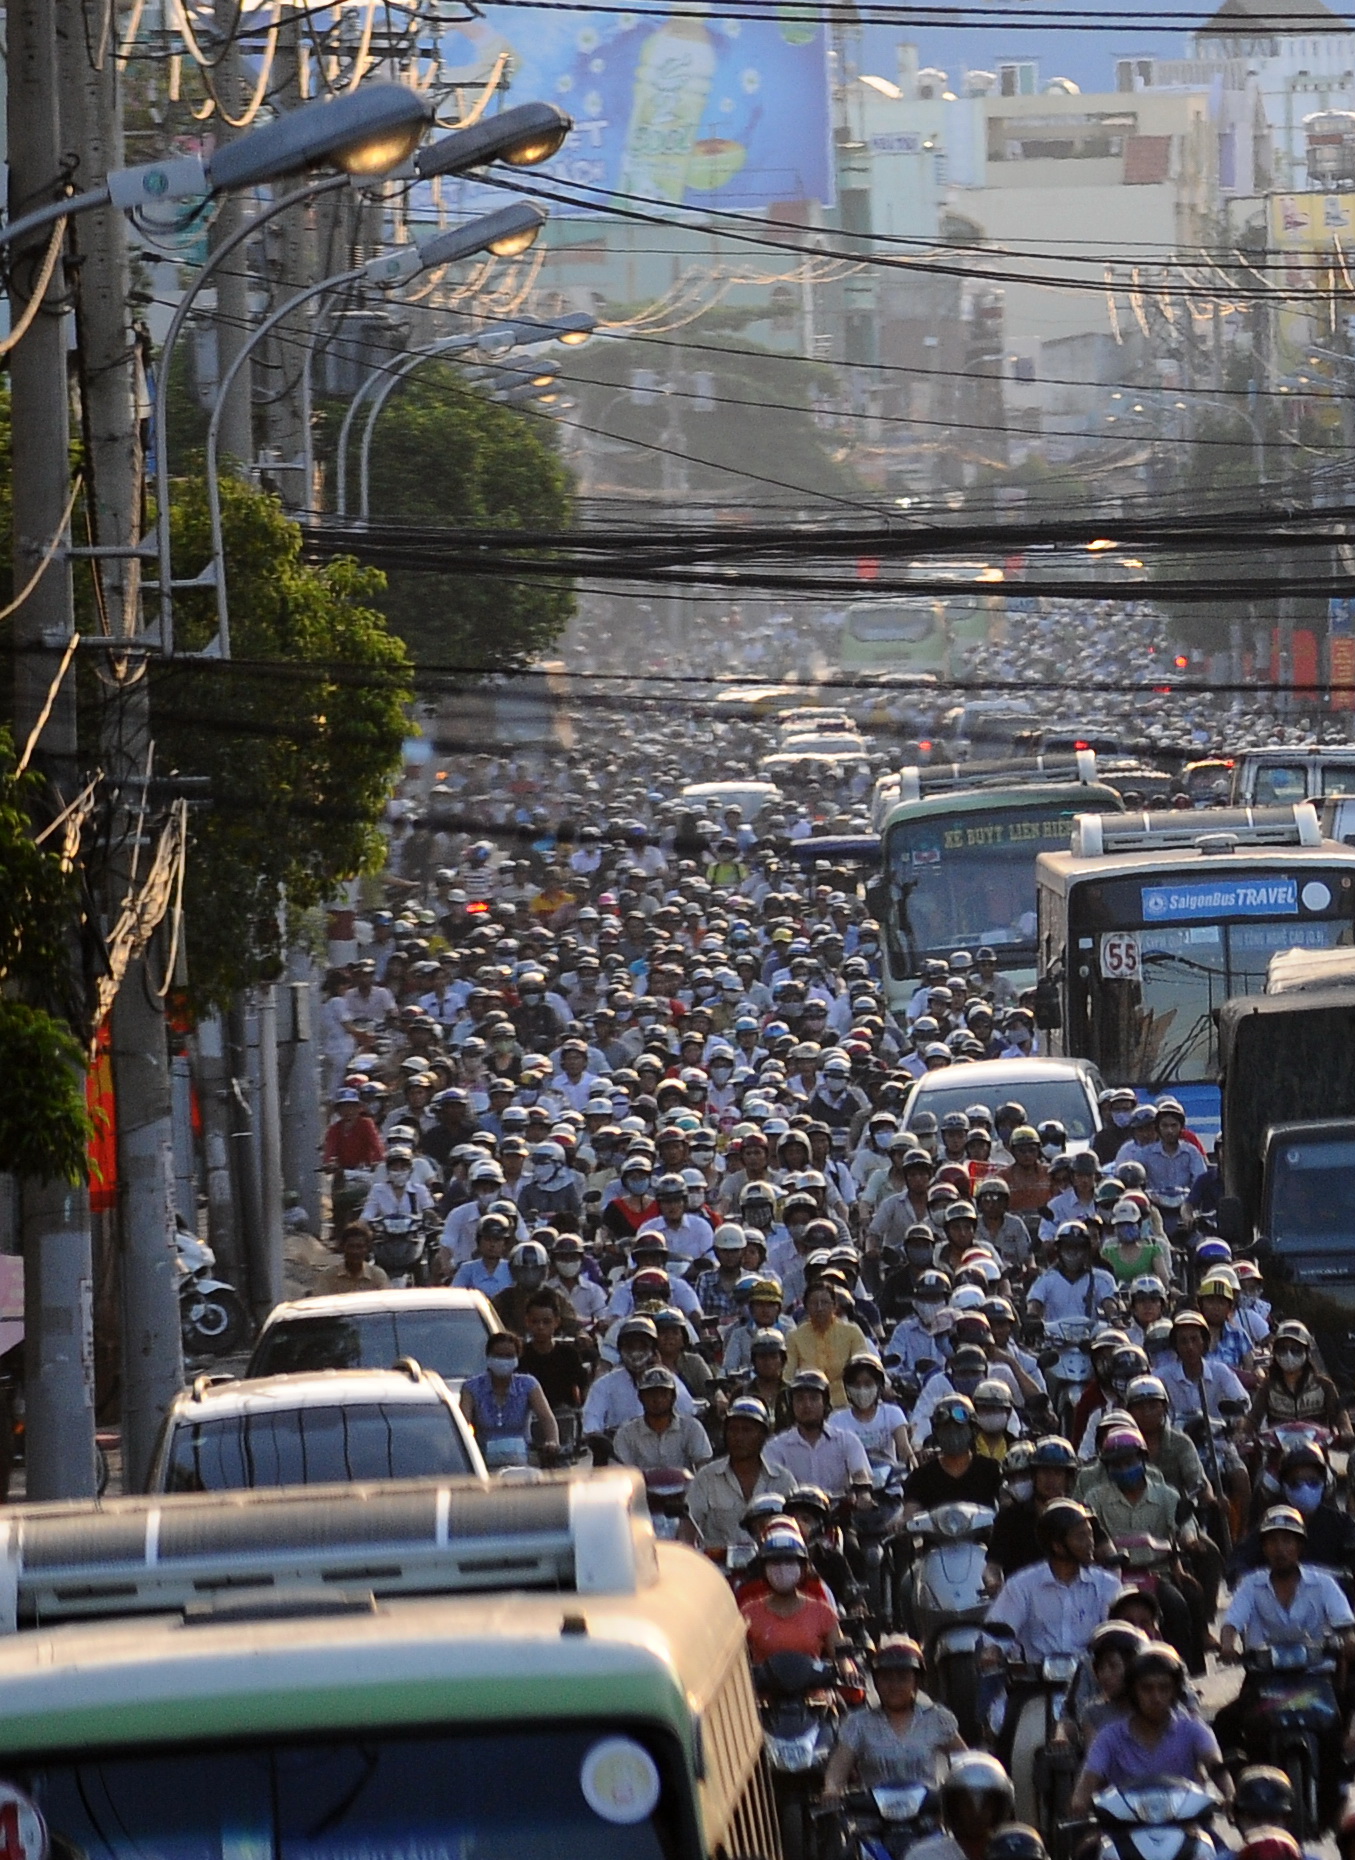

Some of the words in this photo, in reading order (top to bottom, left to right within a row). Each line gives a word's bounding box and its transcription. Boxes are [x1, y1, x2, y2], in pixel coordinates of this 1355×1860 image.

[1169, 892, 1236, 910] SaigonBus
[1235, 886, 1295, 907] TRAVEL
[1108, 943, 1137, 971] 55
